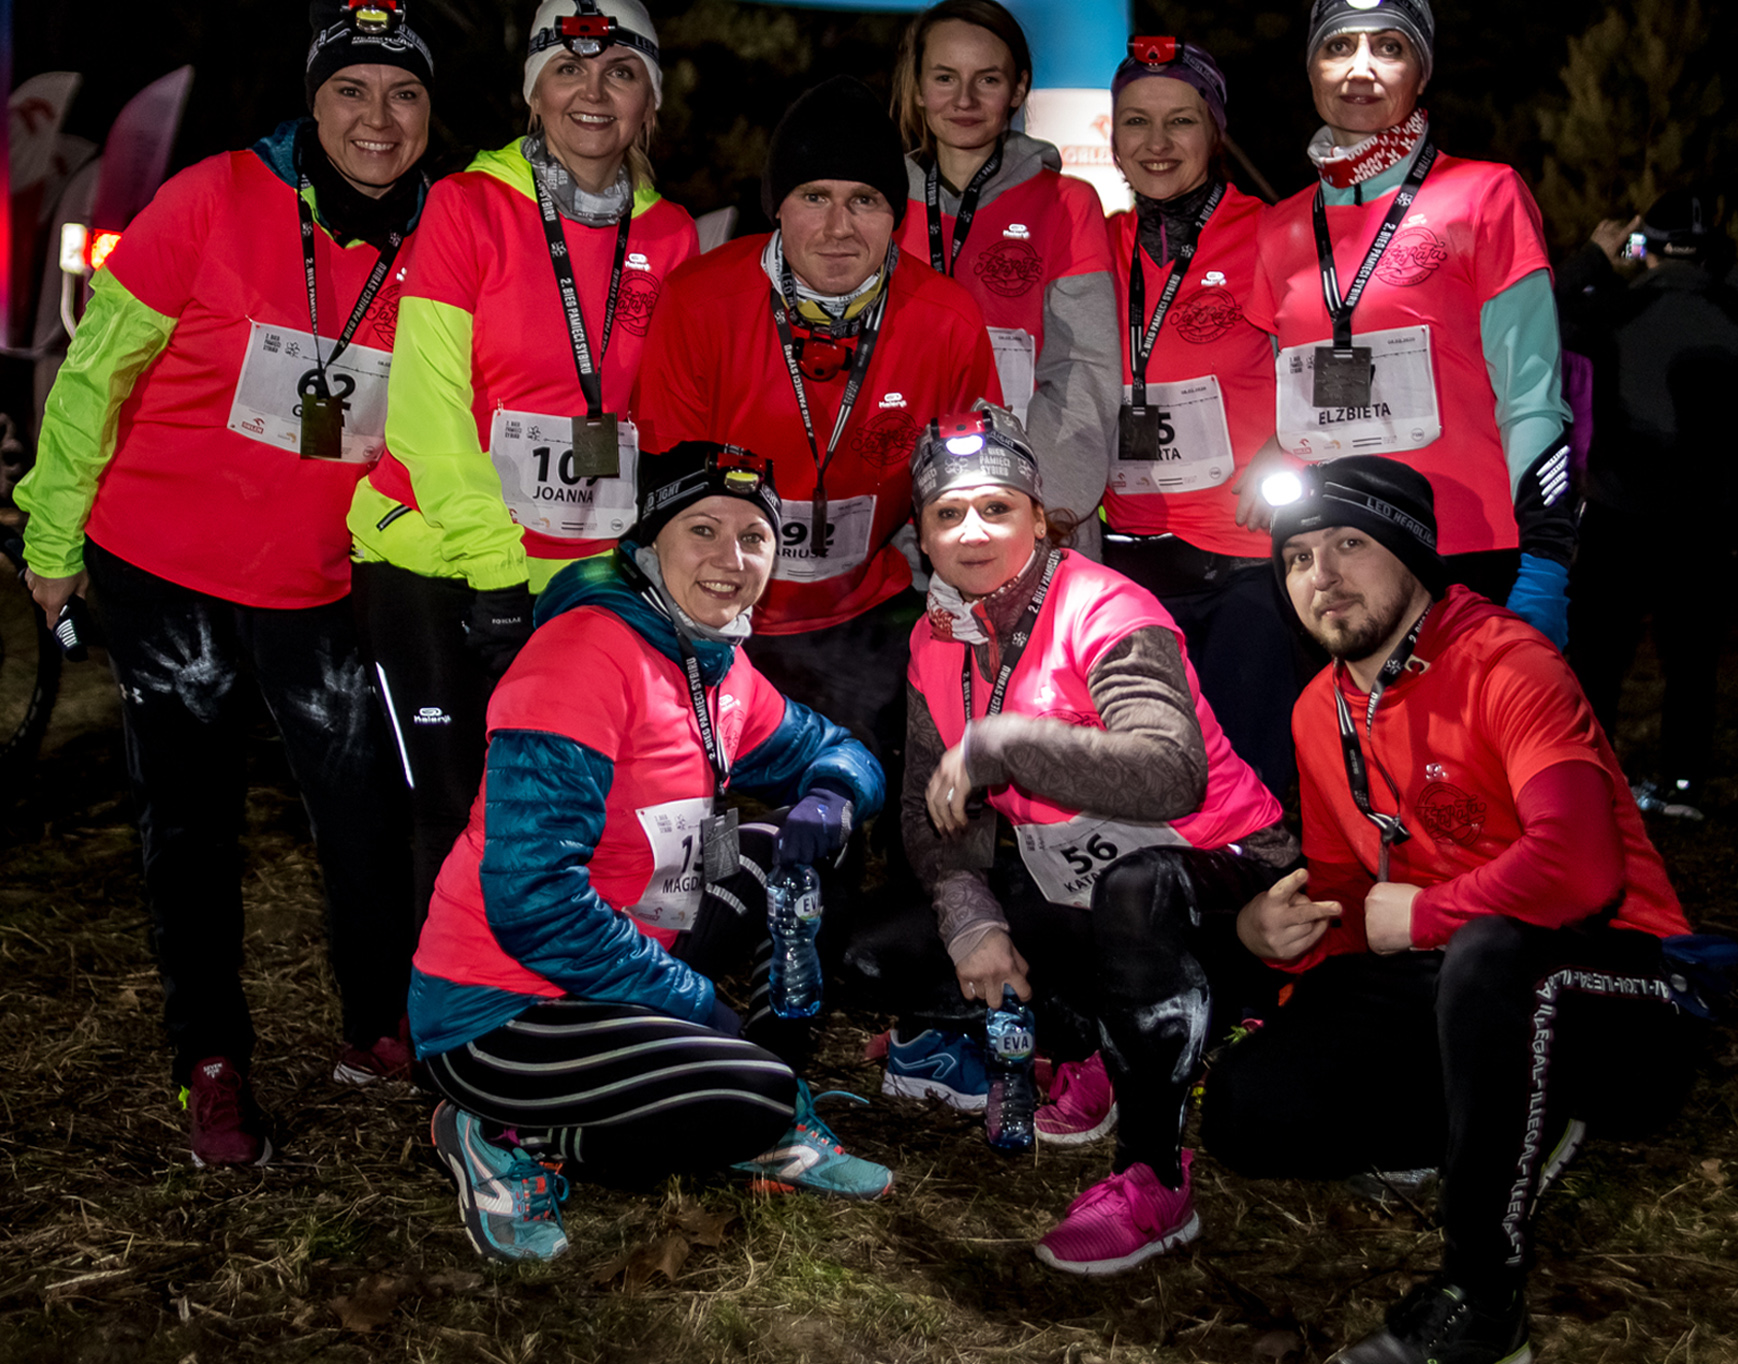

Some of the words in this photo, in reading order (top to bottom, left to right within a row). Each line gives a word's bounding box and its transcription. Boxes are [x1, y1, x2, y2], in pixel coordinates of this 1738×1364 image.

[1374, 230, 1392, 249] BIEG
[367, 261, 388, 291] SYBIRU
[1162, 273, 1182, 303] SYBIRU
[1345, 275, 1367, 308] SYBIRU
[562, 287, 577, 307] BIEG
[575, 342, 593, 375] SYBIRU
[1158, 412, 1175, 445] 5
[532, 446, 601, 487] 10
[532, 485, 594, 504] JOANNA
[1366, 497, 1391, 517] LED
[1393, 512, 1437, 547] HEADLIG
[1032, 585, 1047, 605] BIEG
[686, 656, 702, 692] SYBIRU
[994, 664, 1012, 697] SYBIRU
[1060, 833, 1119, 875] 56
[1003, 1036, 1029, 1050] EVA
